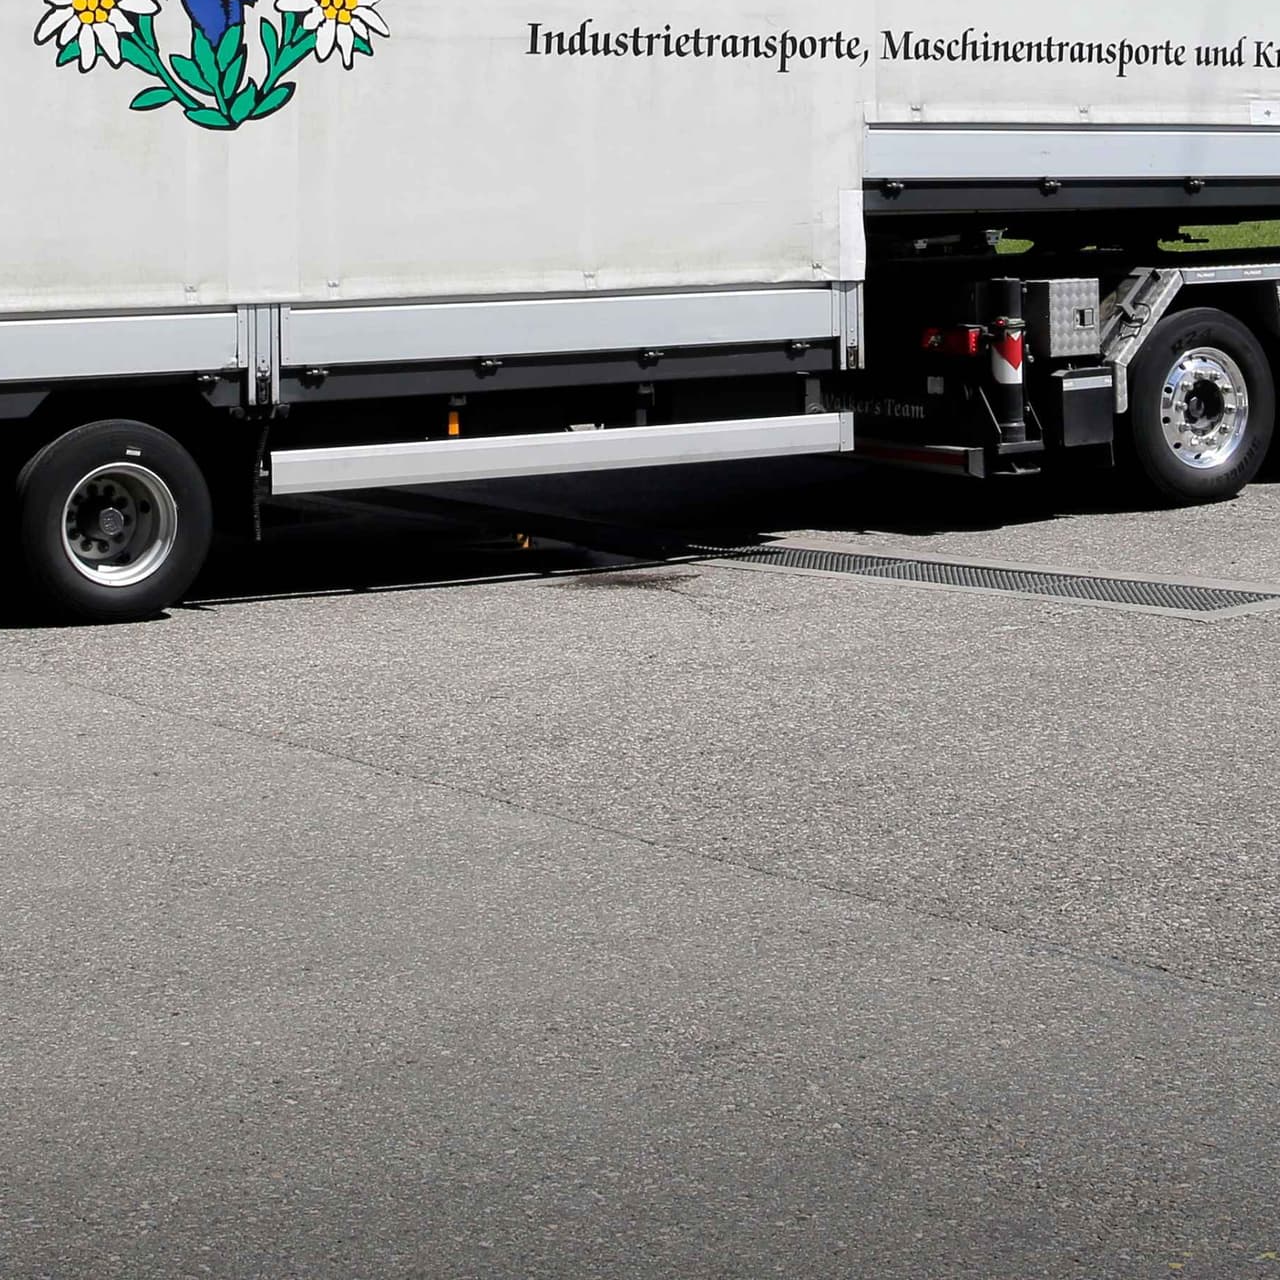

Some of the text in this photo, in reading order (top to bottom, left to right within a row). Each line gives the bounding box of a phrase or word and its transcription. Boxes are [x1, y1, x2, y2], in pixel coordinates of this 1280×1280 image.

[526, 18, 869, 73] Industrietransporte,
[880, 27, 1186, 78] Maschinentransporte
[1195, 38, 1245, 67] und
[884, 398, 926, 420] Team
